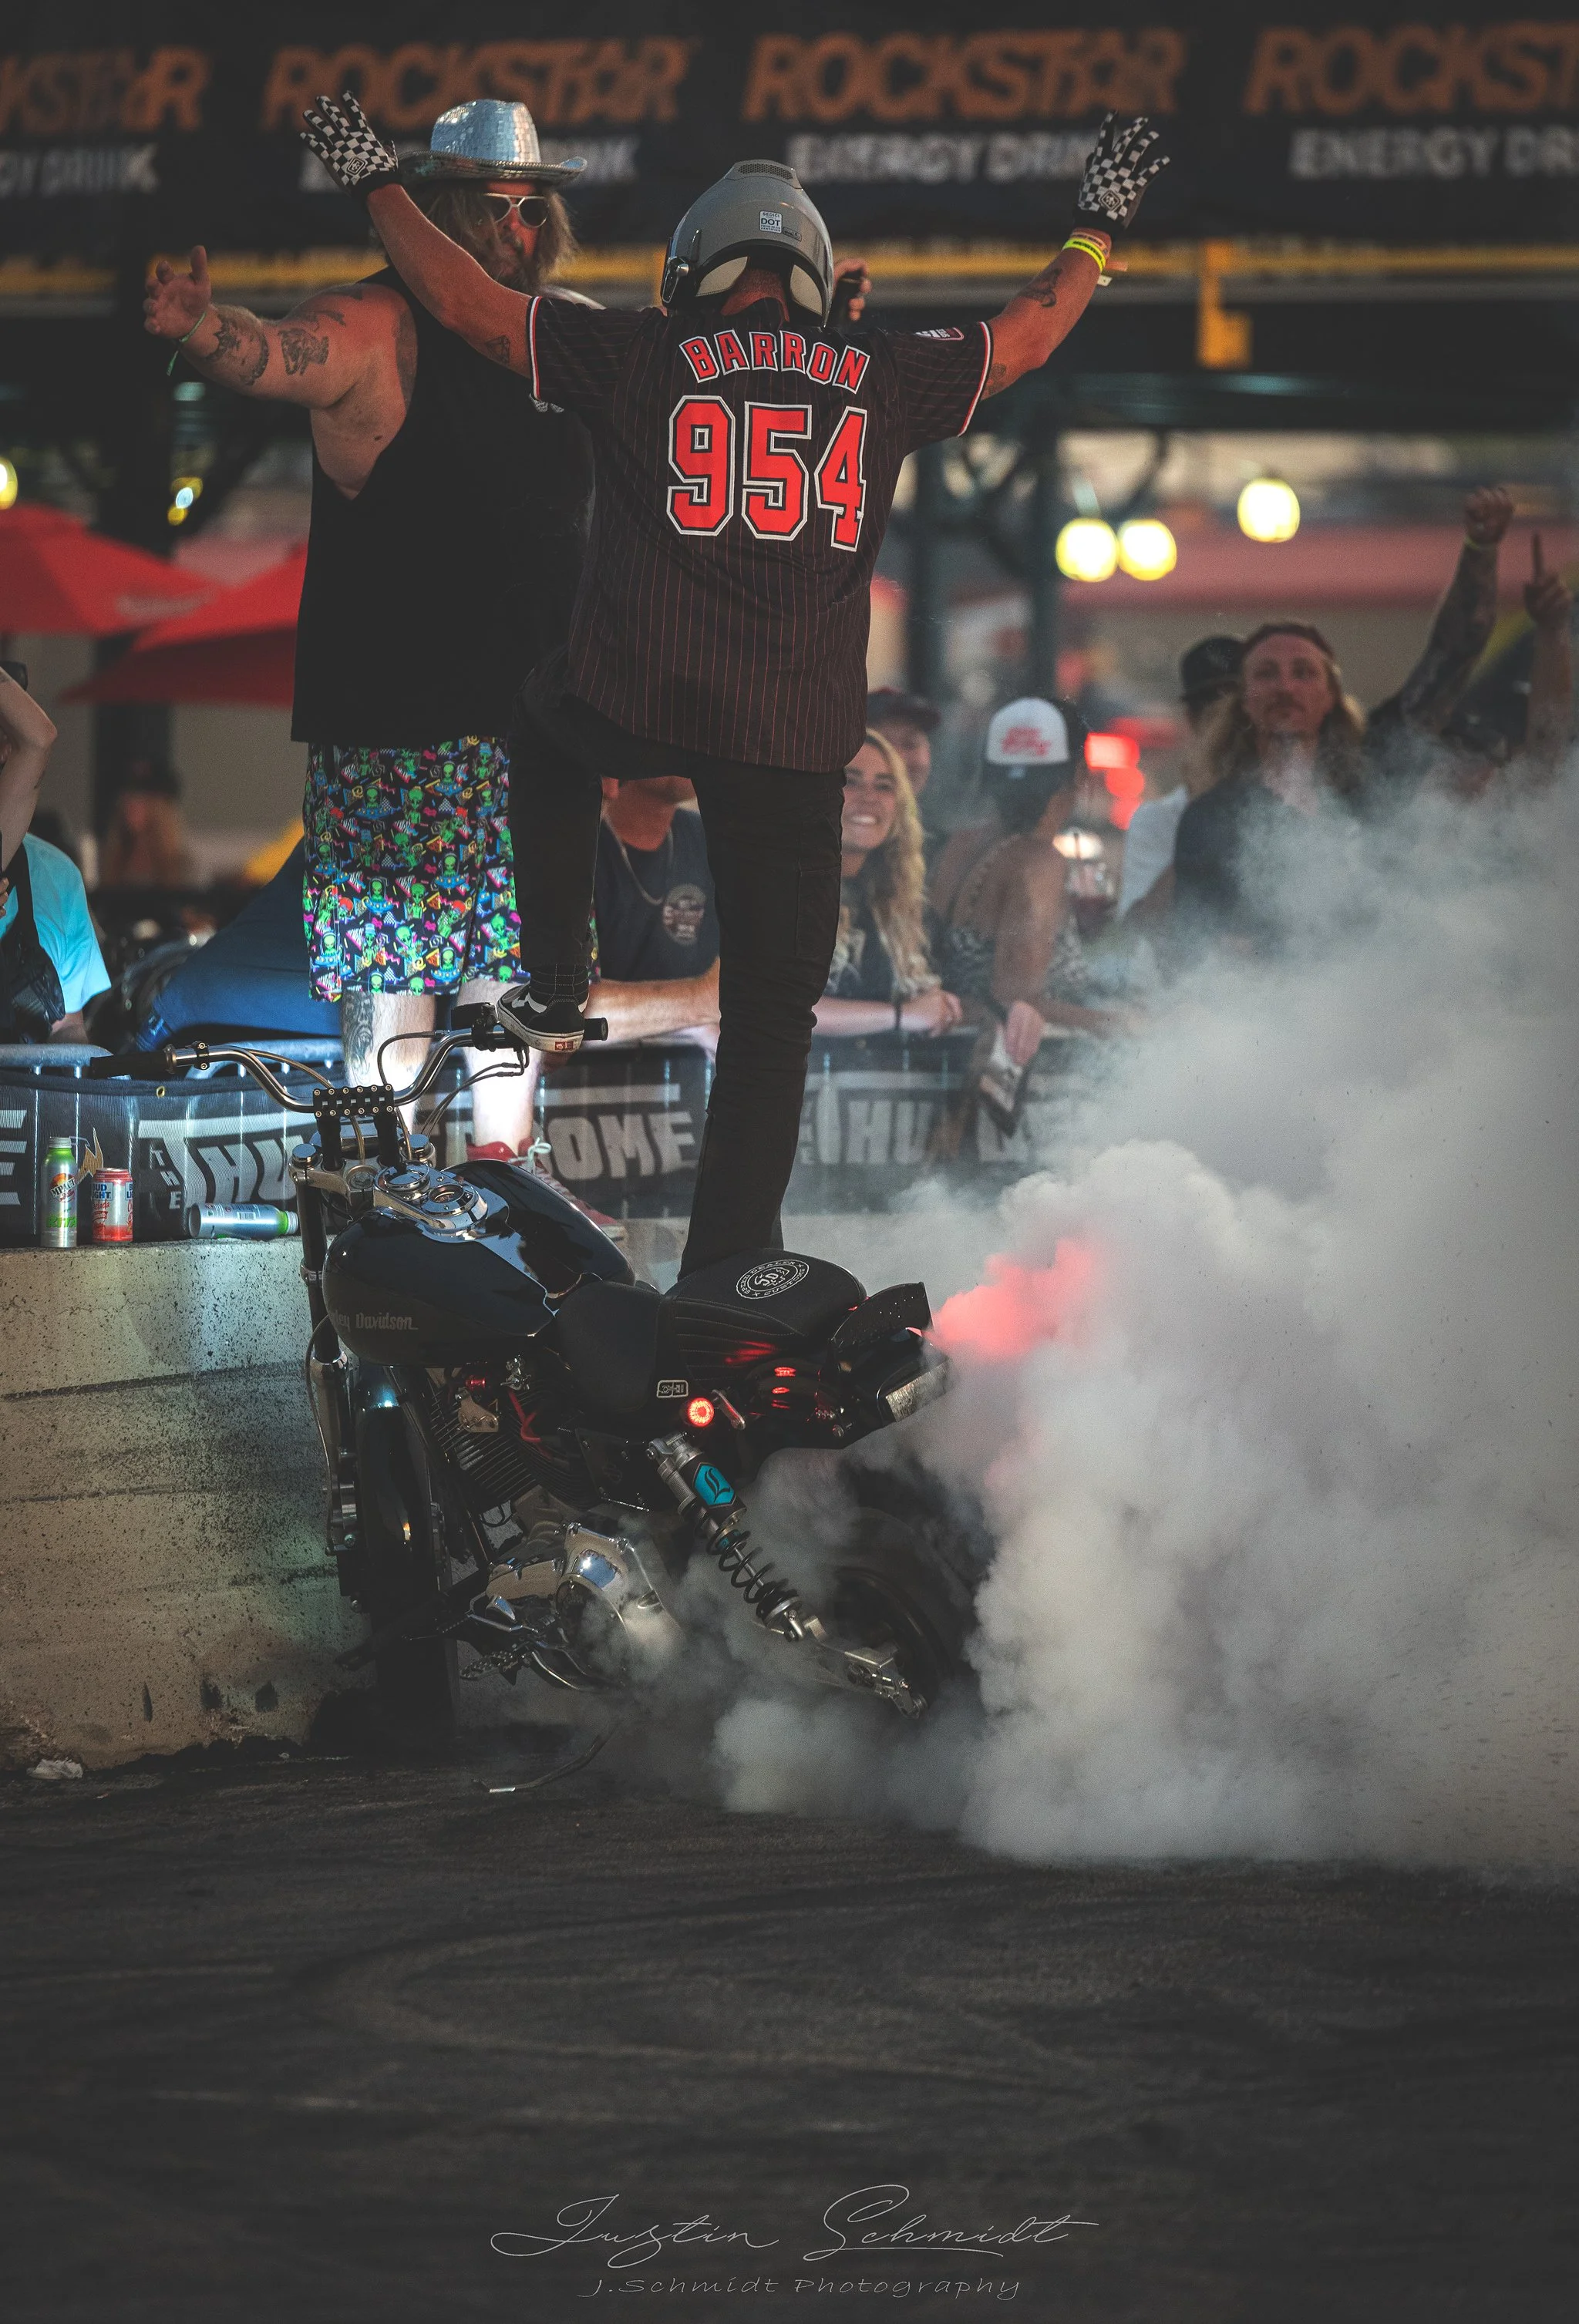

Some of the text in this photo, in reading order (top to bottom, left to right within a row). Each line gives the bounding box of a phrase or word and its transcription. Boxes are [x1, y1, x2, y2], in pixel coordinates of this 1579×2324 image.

[262, 37, 688, 129] ROCKSTAR
[742, 26, 1188, 120] ROCKSTAR
[1290, 128, 1497, 180] ENERGY
[679, 328, 870, 394] BARRON
[666, 395, 867, 552] 954
[355, 1312, 419, 1330] Davidson
